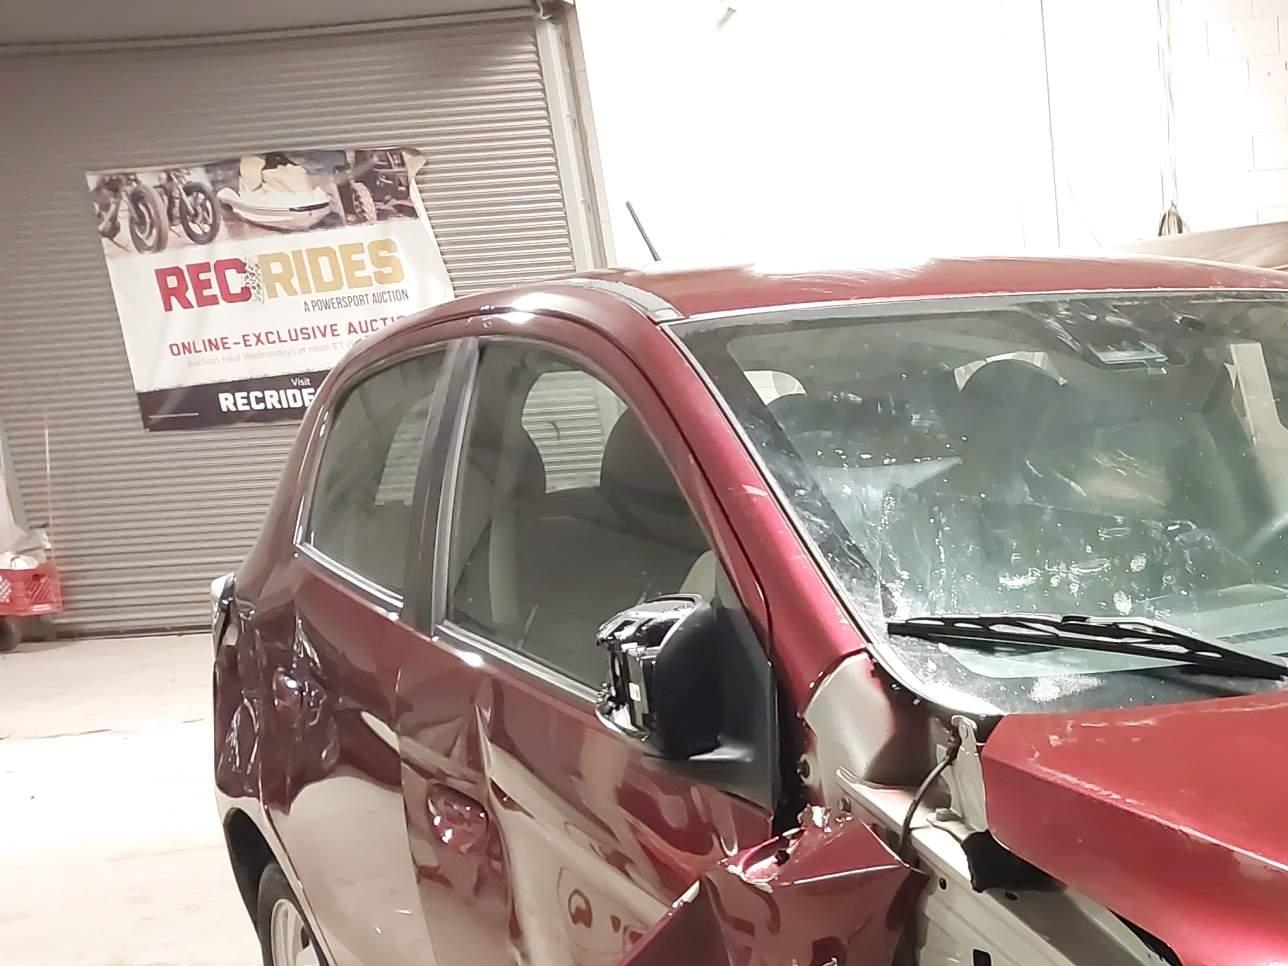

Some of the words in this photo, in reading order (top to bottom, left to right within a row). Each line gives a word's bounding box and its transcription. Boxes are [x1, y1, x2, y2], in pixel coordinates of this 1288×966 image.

[154, 257, 252, 312] REC
[258, 238, 404, 299] RIDES
[303, 301, 311, 312] A
[311, 293, 370, 312] POWERSPORT
[371, 288, 409, 304] AUCTION
[168, 323, 340, 356] ONLINE-EXCLUSIVE
[290, 378, 311, 387] Visit
